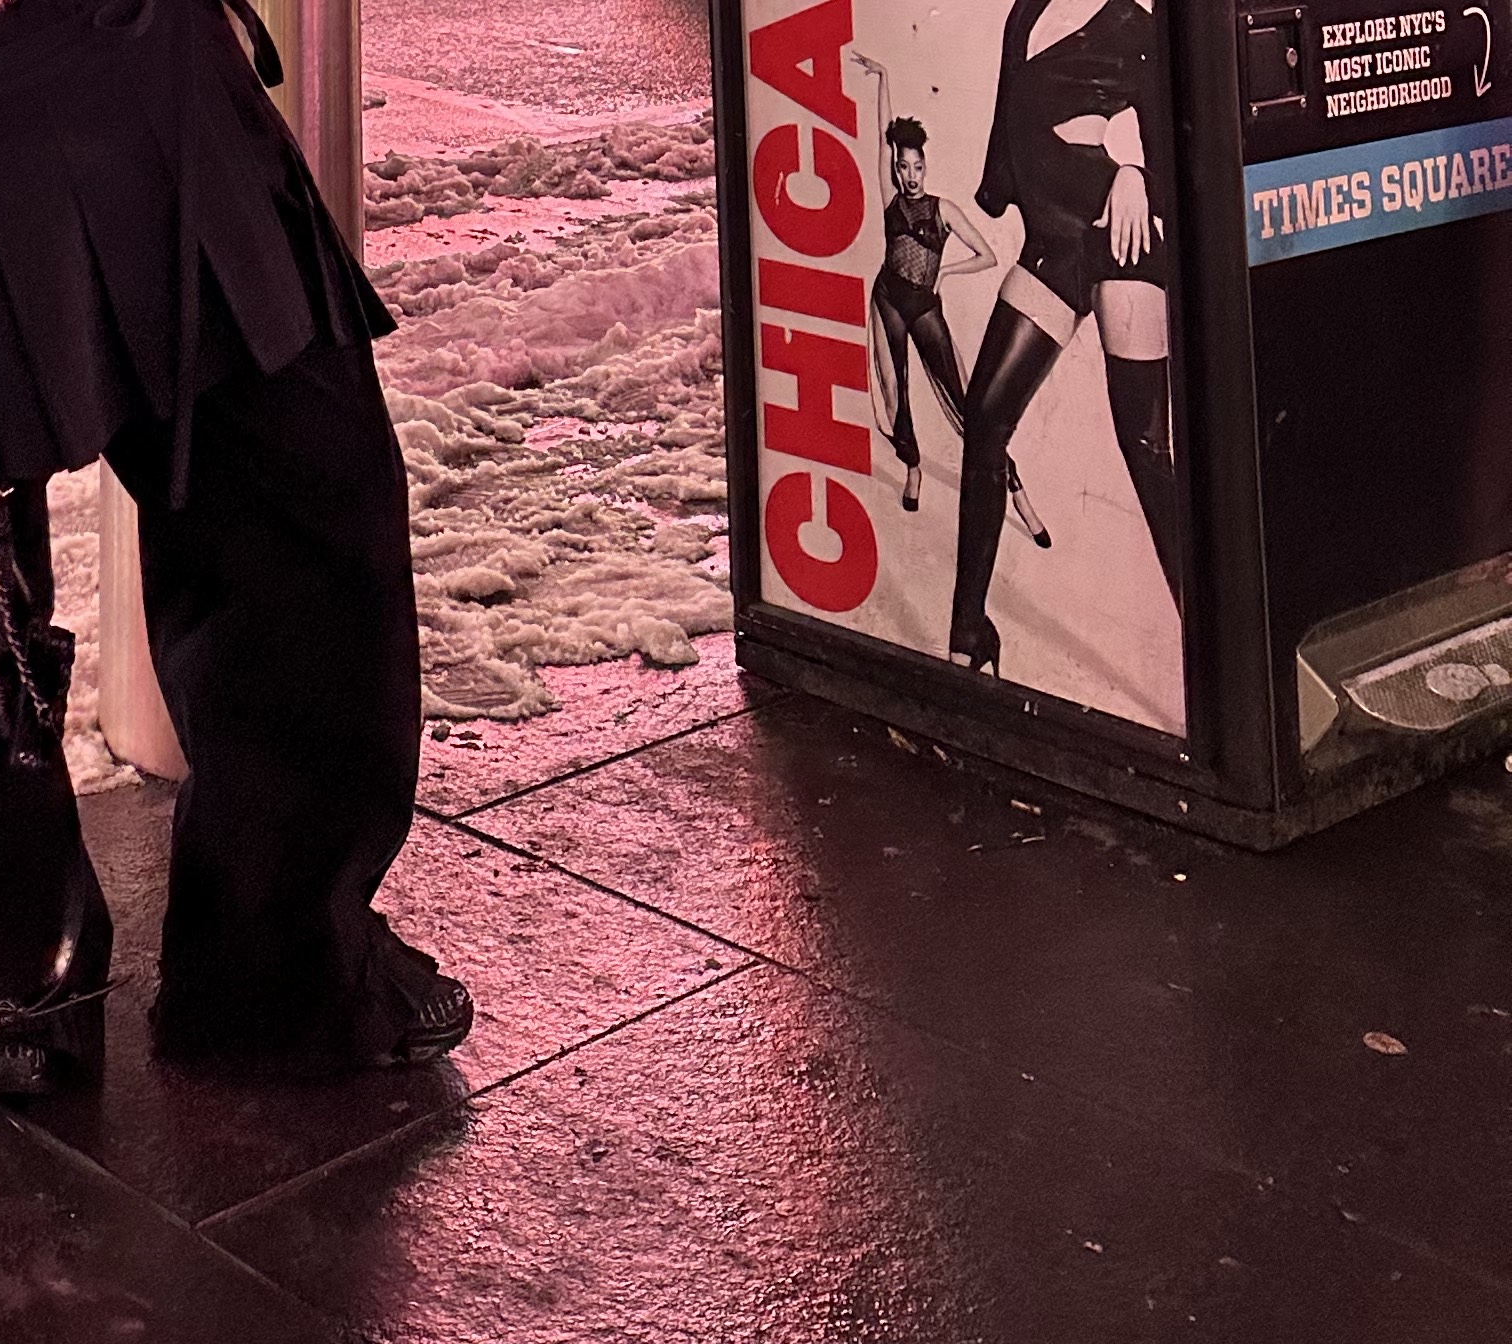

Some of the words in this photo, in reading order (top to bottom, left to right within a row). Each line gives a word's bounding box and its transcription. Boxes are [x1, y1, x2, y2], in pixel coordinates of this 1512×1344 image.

[1322, 16, 1397, 49] EXPLORE
[1399, 10, 1446, 38] NYC'S
[1324, 54, 1372, 83] MOST
[1376, 46, 1431, 75] ICONIC
[1326, 76, 1452, 118] NEIGHBORHOOD
[1253, 171, 1372, 240] TIMES
[1381, 143, 1512, 212] SQUARE
